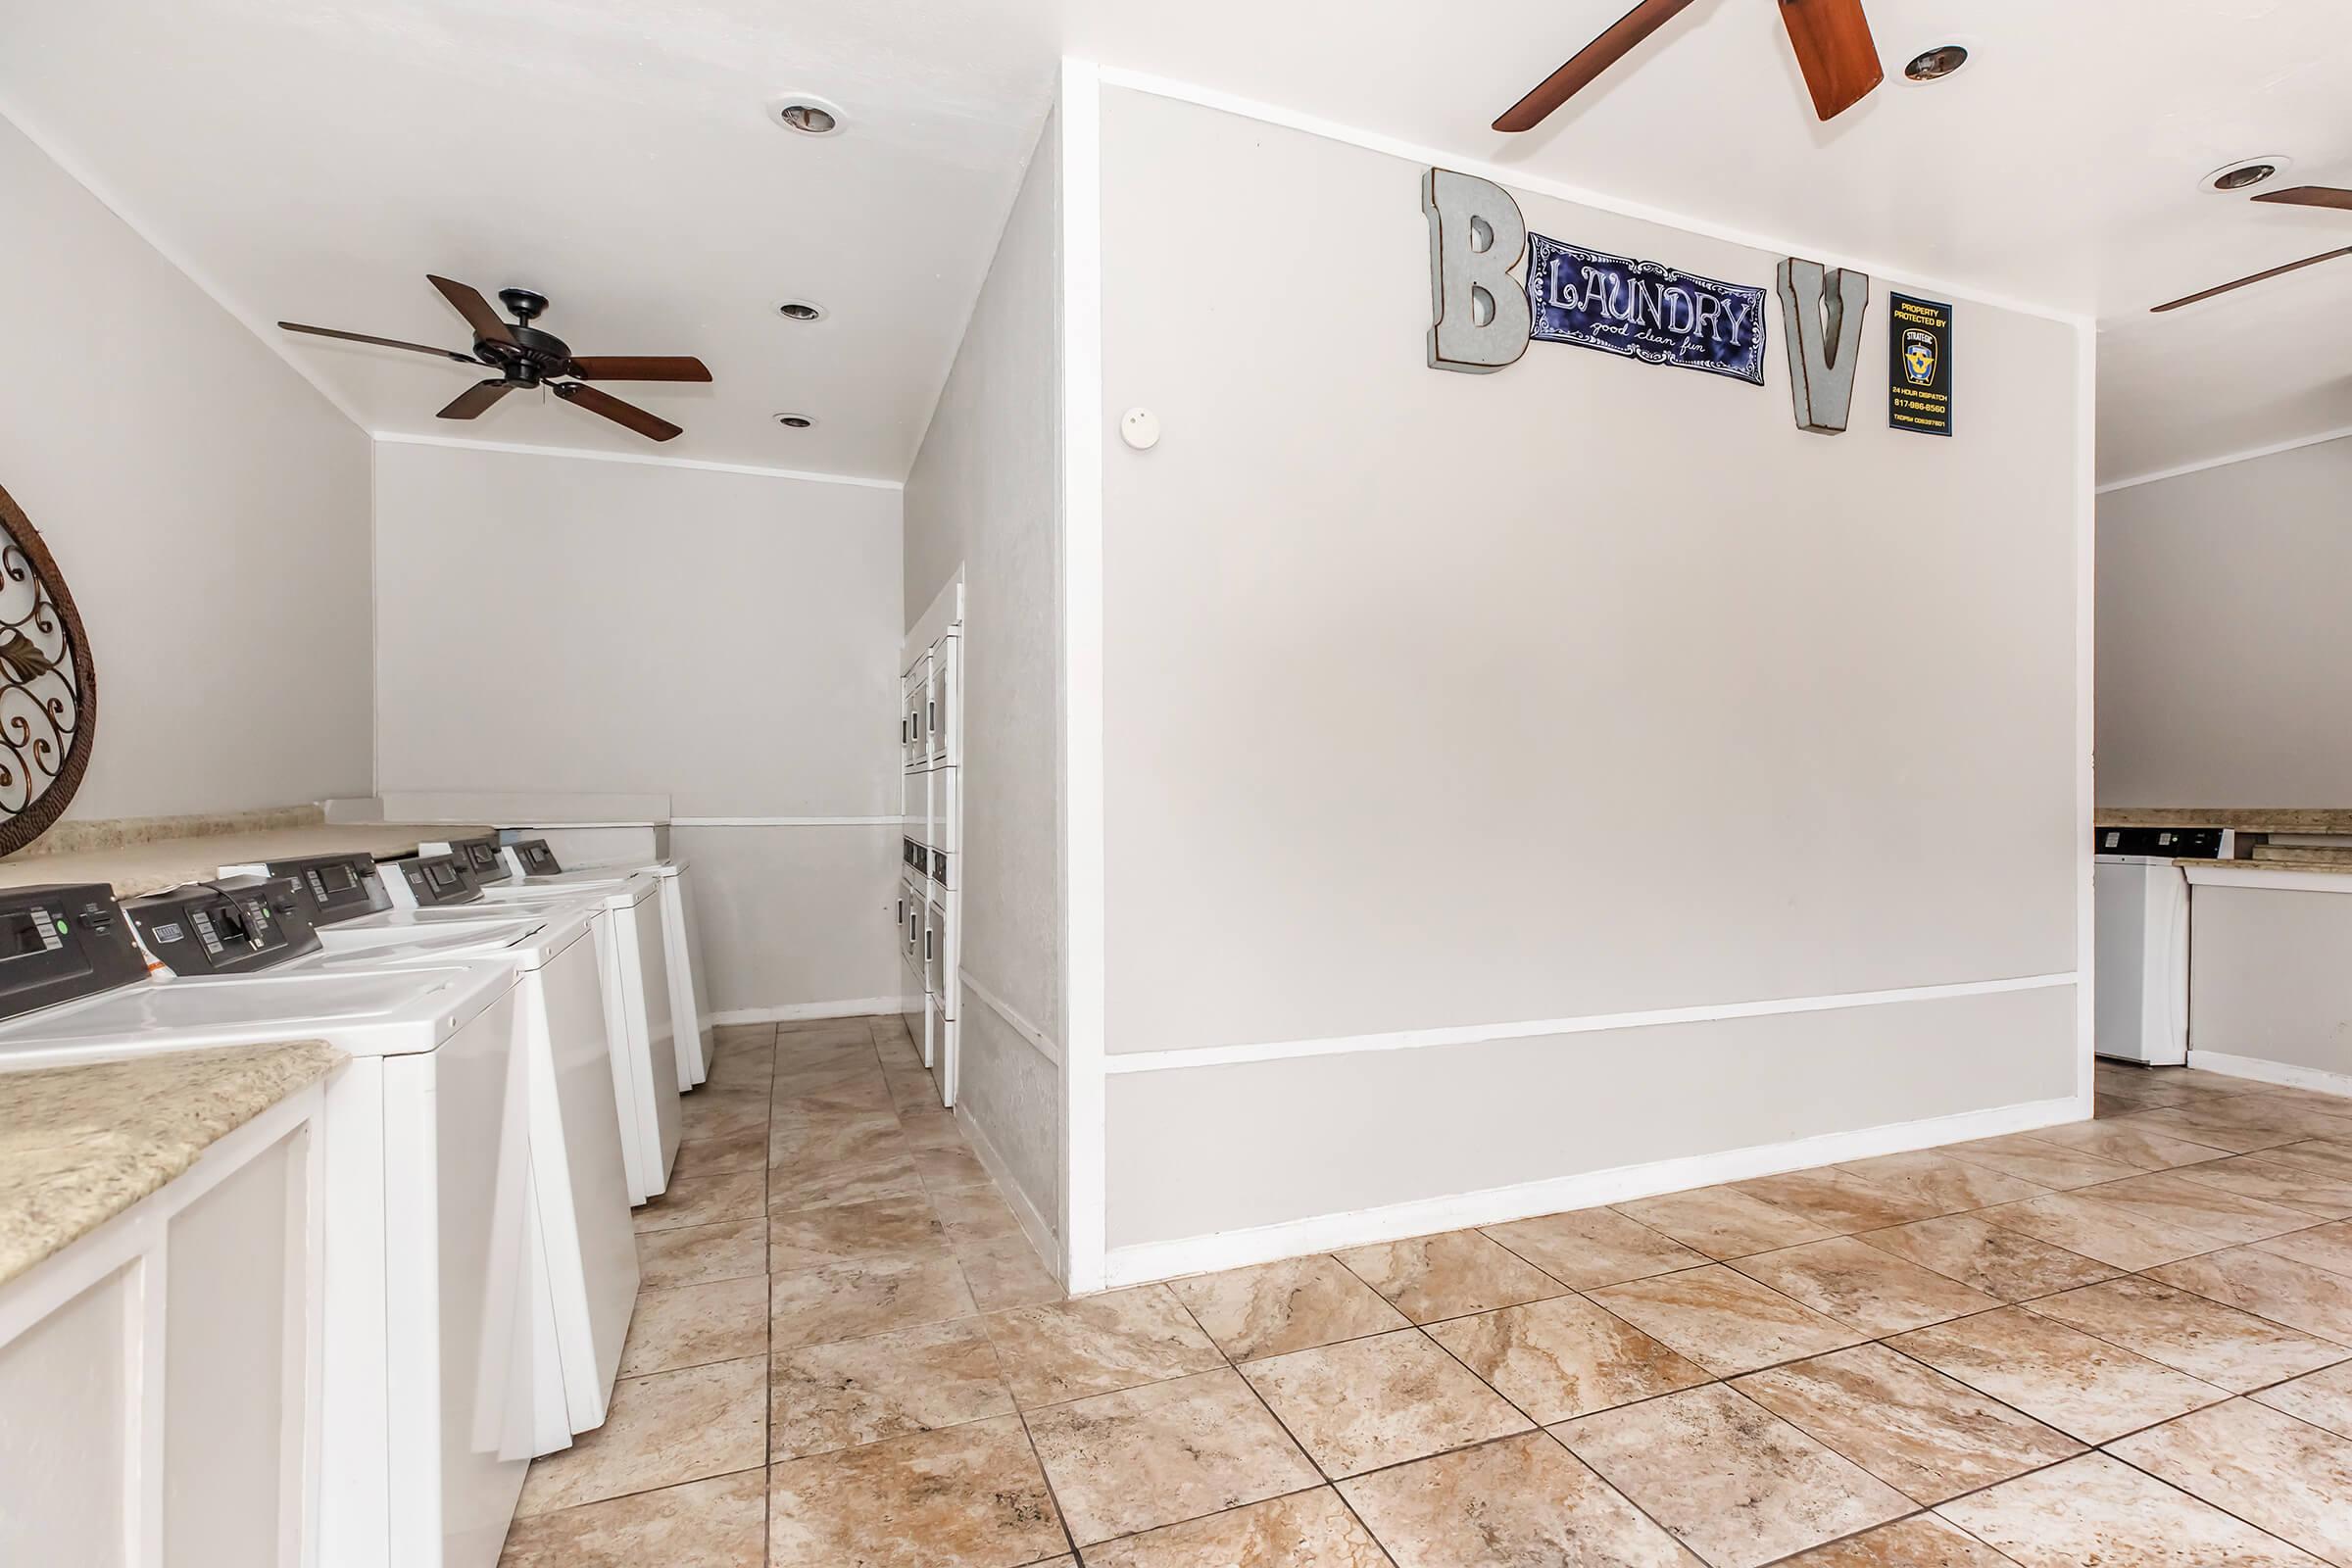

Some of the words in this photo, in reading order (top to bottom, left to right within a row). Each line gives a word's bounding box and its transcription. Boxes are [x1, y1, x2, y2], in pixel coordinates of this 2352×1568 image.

[1421, 167, 1532, 375] B
[1548, 259, 1752, 347] LAUNDRY
[1902, 303, 1938, 318] PROPERTY
[1894, 310, 1935, 325] PROTECTED
[1590, 322, 1630, 338] good
[1634, 328, 1677, 347] clean
[1679, 336, 1706, 354] fun
[1777, 257, 1869, 436] V
[1907, 331, 1933, 344] STRATEGIC
[1901, 388, 1918, 397] HOUR
[1918, 391, 1947, 401] DISPATCH
